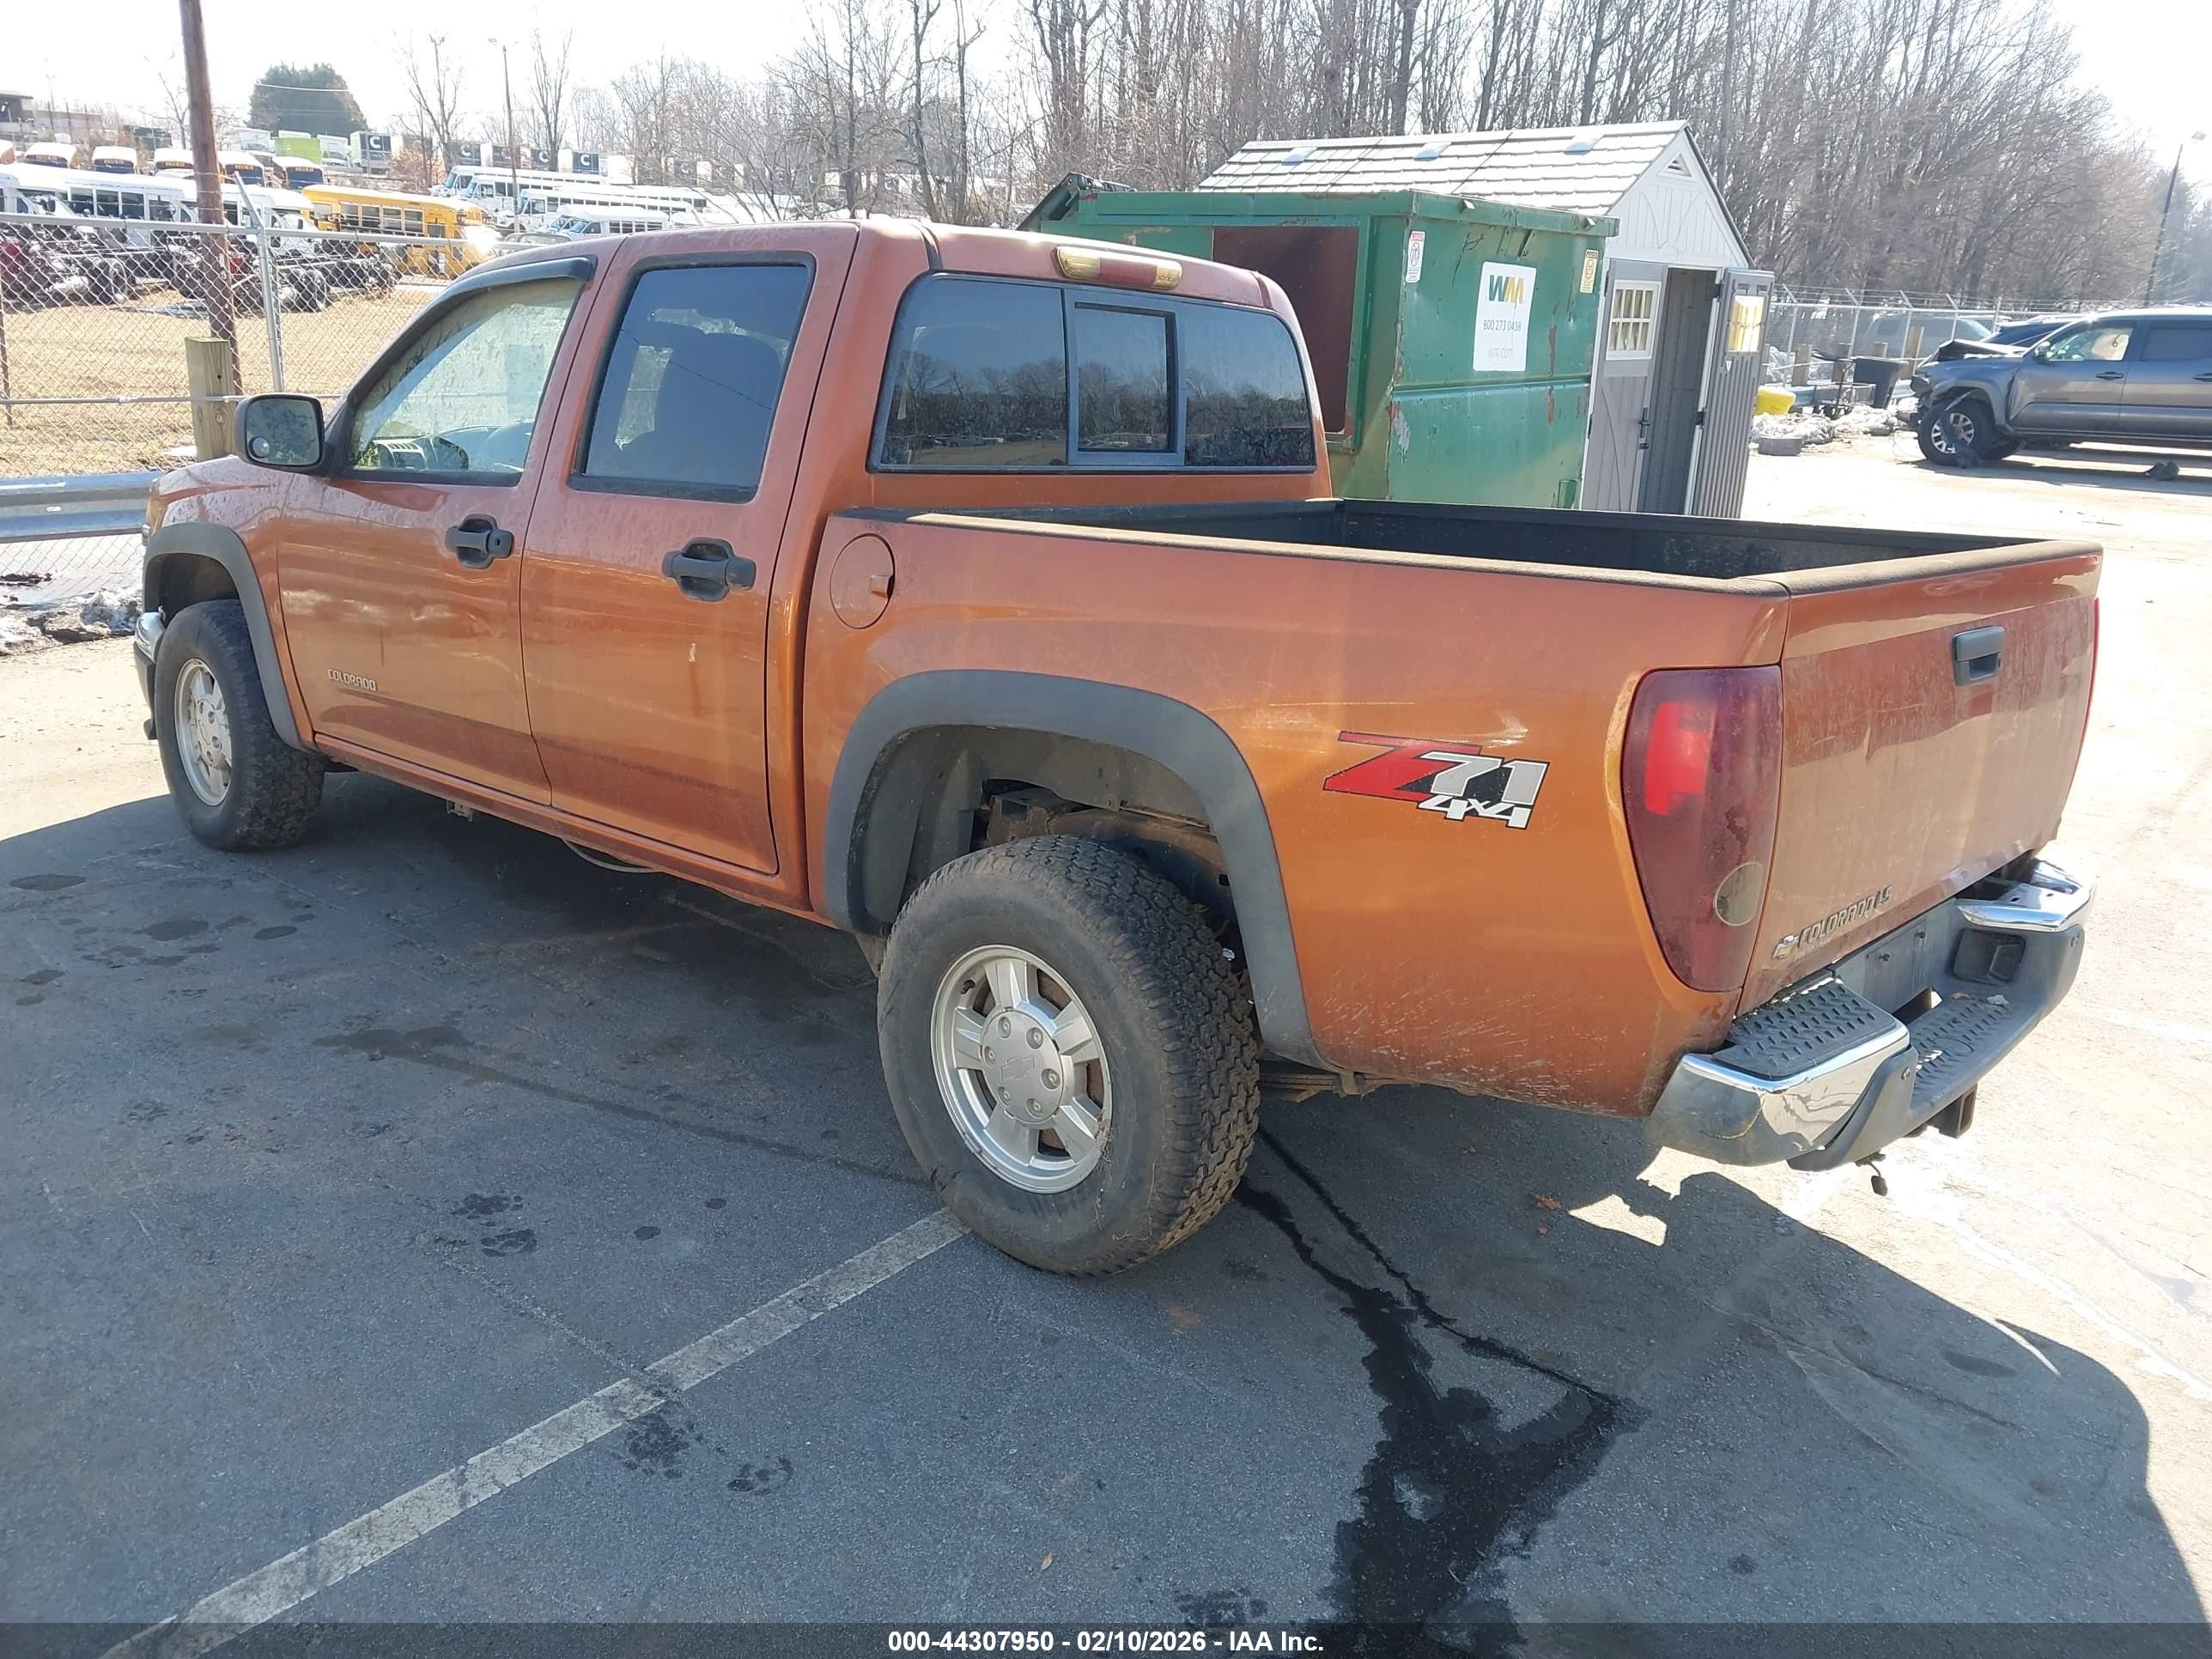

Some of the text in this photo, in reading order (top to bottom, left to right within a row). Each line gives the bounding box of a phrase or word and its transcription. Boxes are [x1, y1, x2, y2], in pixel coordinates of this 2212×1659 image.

[369, 137, 381, 149] C
[580, 154, 591, 167] C
[1488, 274, 1525, 304] WM
[1495, 319, 1506, 331] 273
[327, 668, 377, 691] COLORADO
[1322, 731, 1550, 806] Z71
[1798, 895, 1875, 948] COLORADO
